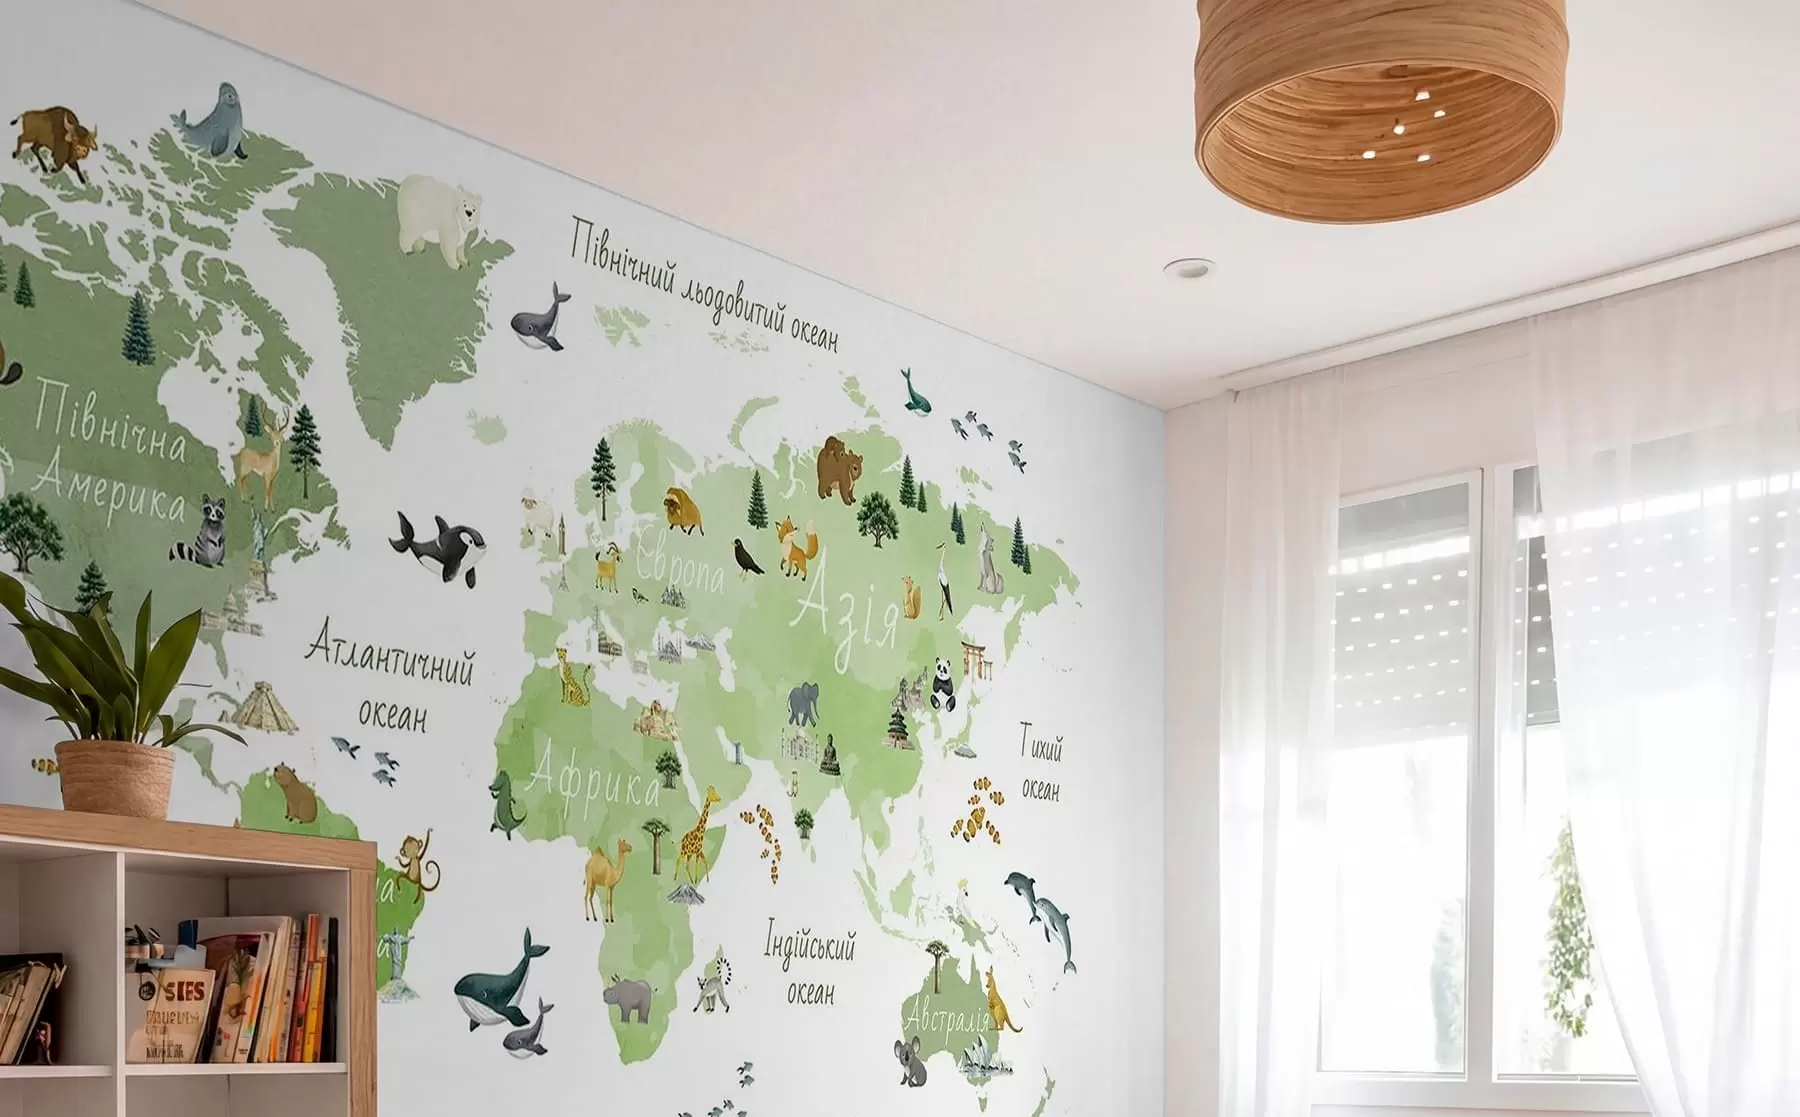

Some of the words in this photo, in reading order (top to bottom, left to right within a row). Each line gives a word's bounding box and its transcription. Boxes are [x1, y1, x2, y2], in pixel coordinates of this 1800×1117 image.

[571, 214, 677, 294] Північний
[680, 279, 787, 334] льодовитий
[790, 317, 839, 354] океан
[35, 375, 186, 463] Північна
[30, 443, 186, 529] Америка
[634, 523, 725, 596] Європа
[788, 544, 900, 676] Азія
[303, 615, 476, 687] Атлантичний
[358, 699, 428, 734] океан
[1019, 720, 1064, 763] Тихий
[523, 735, 660, 822] Африка
[1022, 778, 1061, 803] океан
[763, 916, 857, 973] Індійський
[787, 982, 836, 1006] океан
[904, 994, 991, 1046] Австралія
